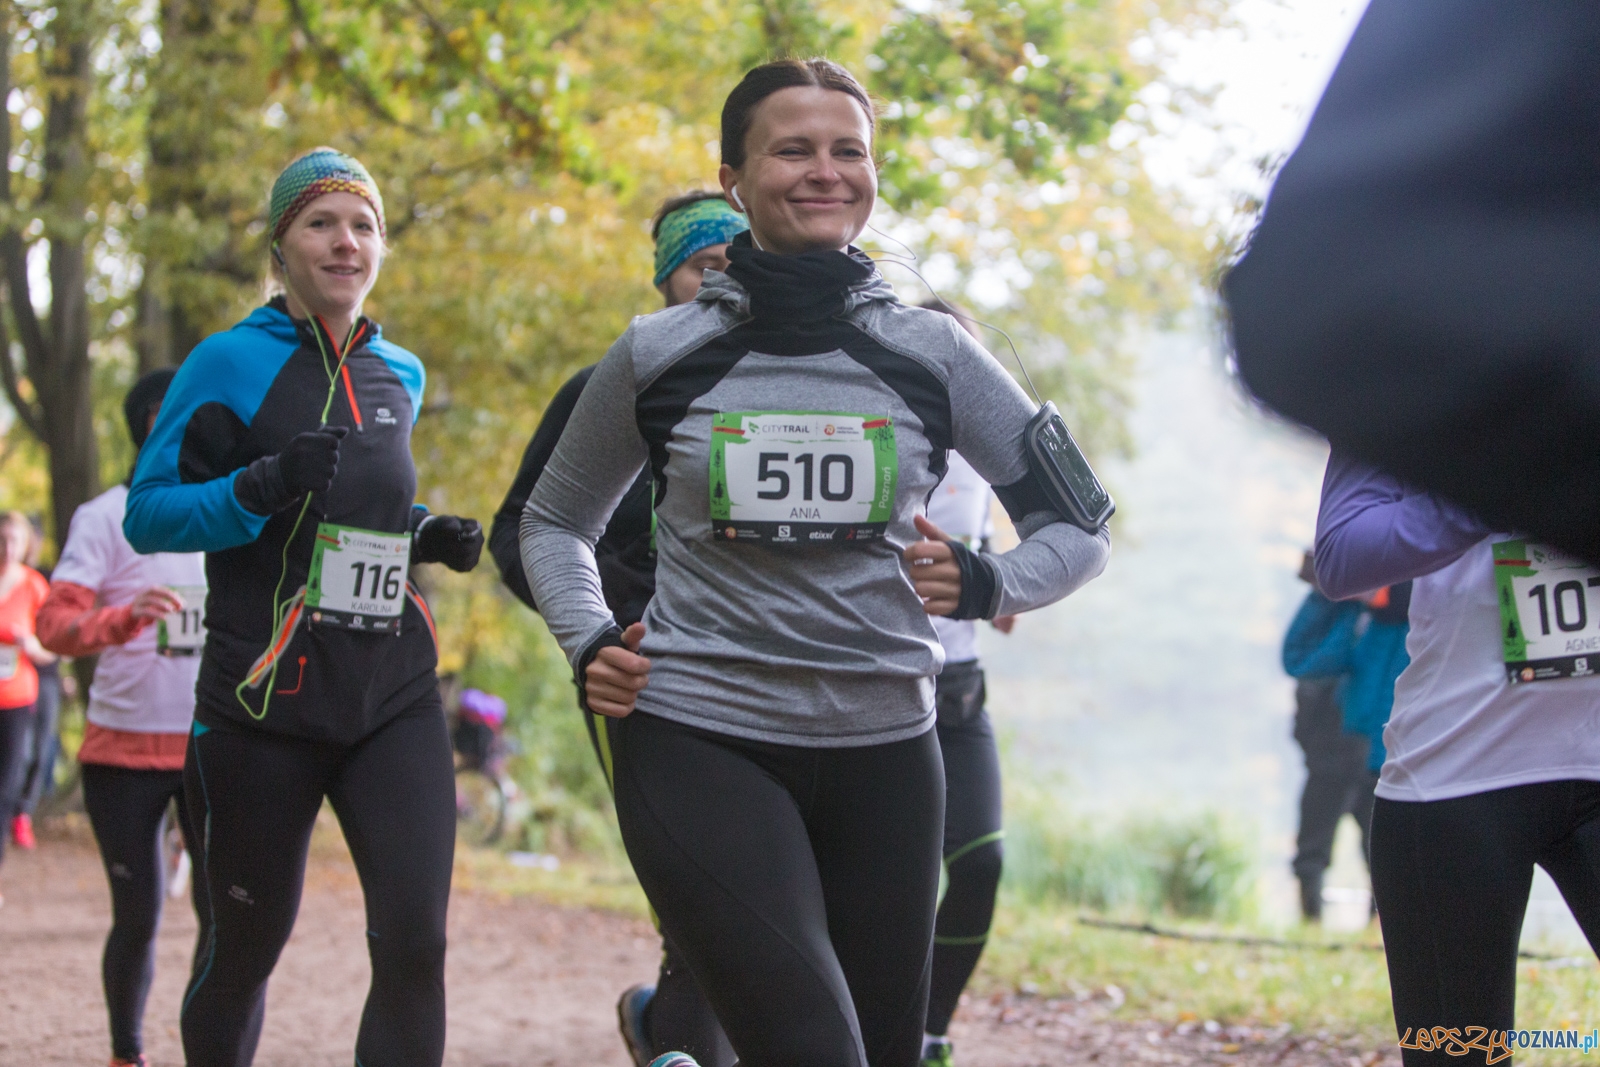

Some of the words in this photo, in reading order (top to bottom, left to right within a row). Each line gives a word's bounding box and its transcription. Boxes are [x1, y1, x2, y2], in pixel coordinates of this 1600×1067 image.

[757, 452, 854, 501] 510
[878, 466, 891, 509] Poznań
[789, 507, 821, 520] ANIA
[350, 561, 401, 600] 116
[350, 601, 392, 613] KAROLINA
[1565, 637, 1600, 653] AGNIE
